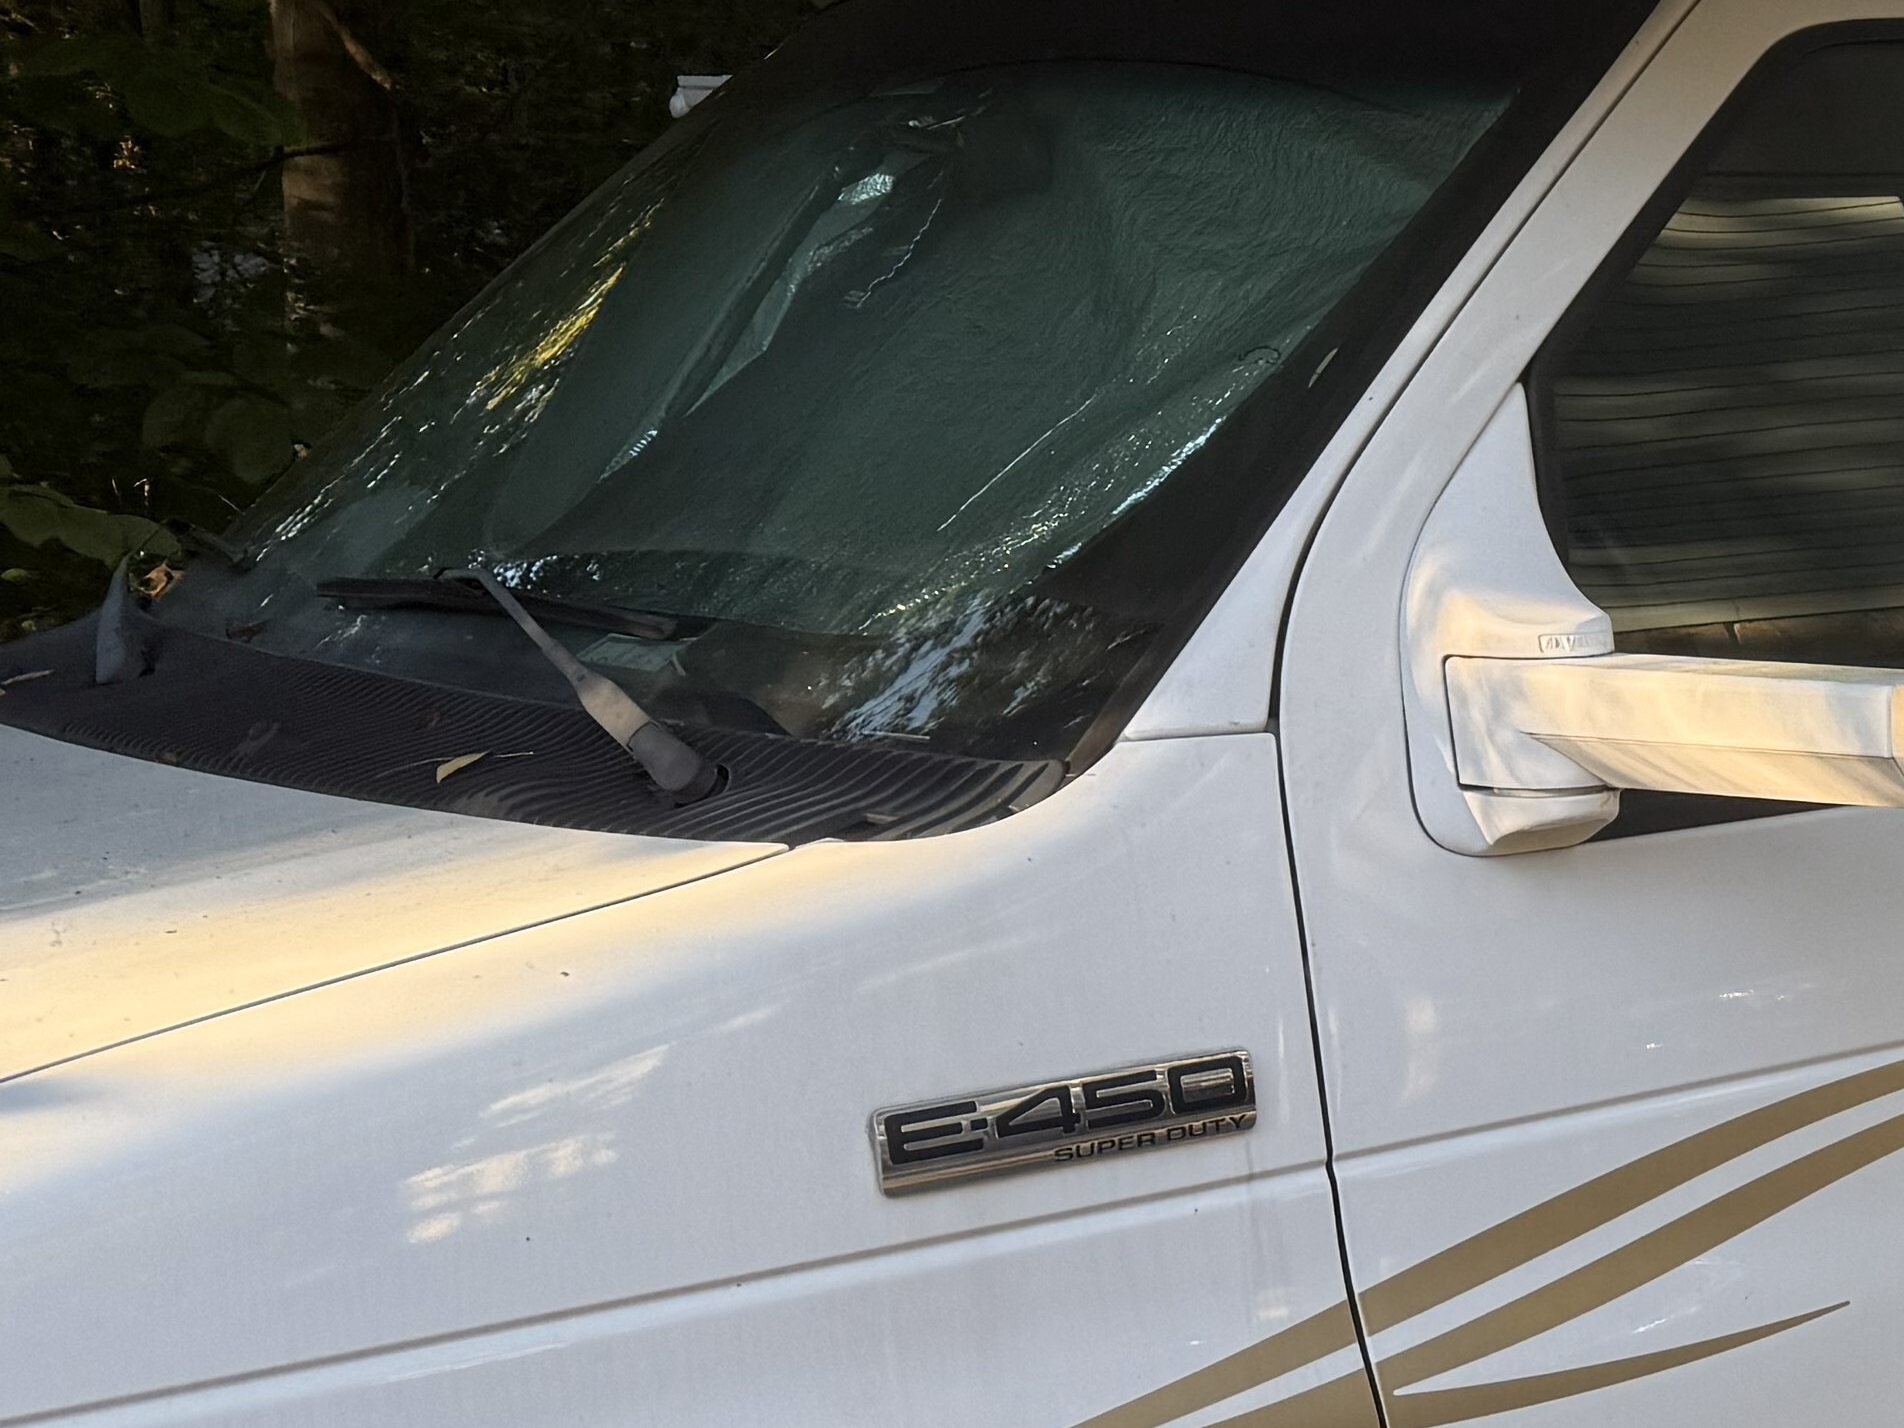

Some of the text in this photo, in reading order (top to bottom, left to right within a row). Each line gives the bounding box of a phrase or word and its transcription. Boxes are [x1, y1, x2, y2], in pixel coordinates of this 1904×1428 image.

[884, 1055, 1248, 1165] E-450
[1054, 1113, 1247, 1162] SUPER DUTY
